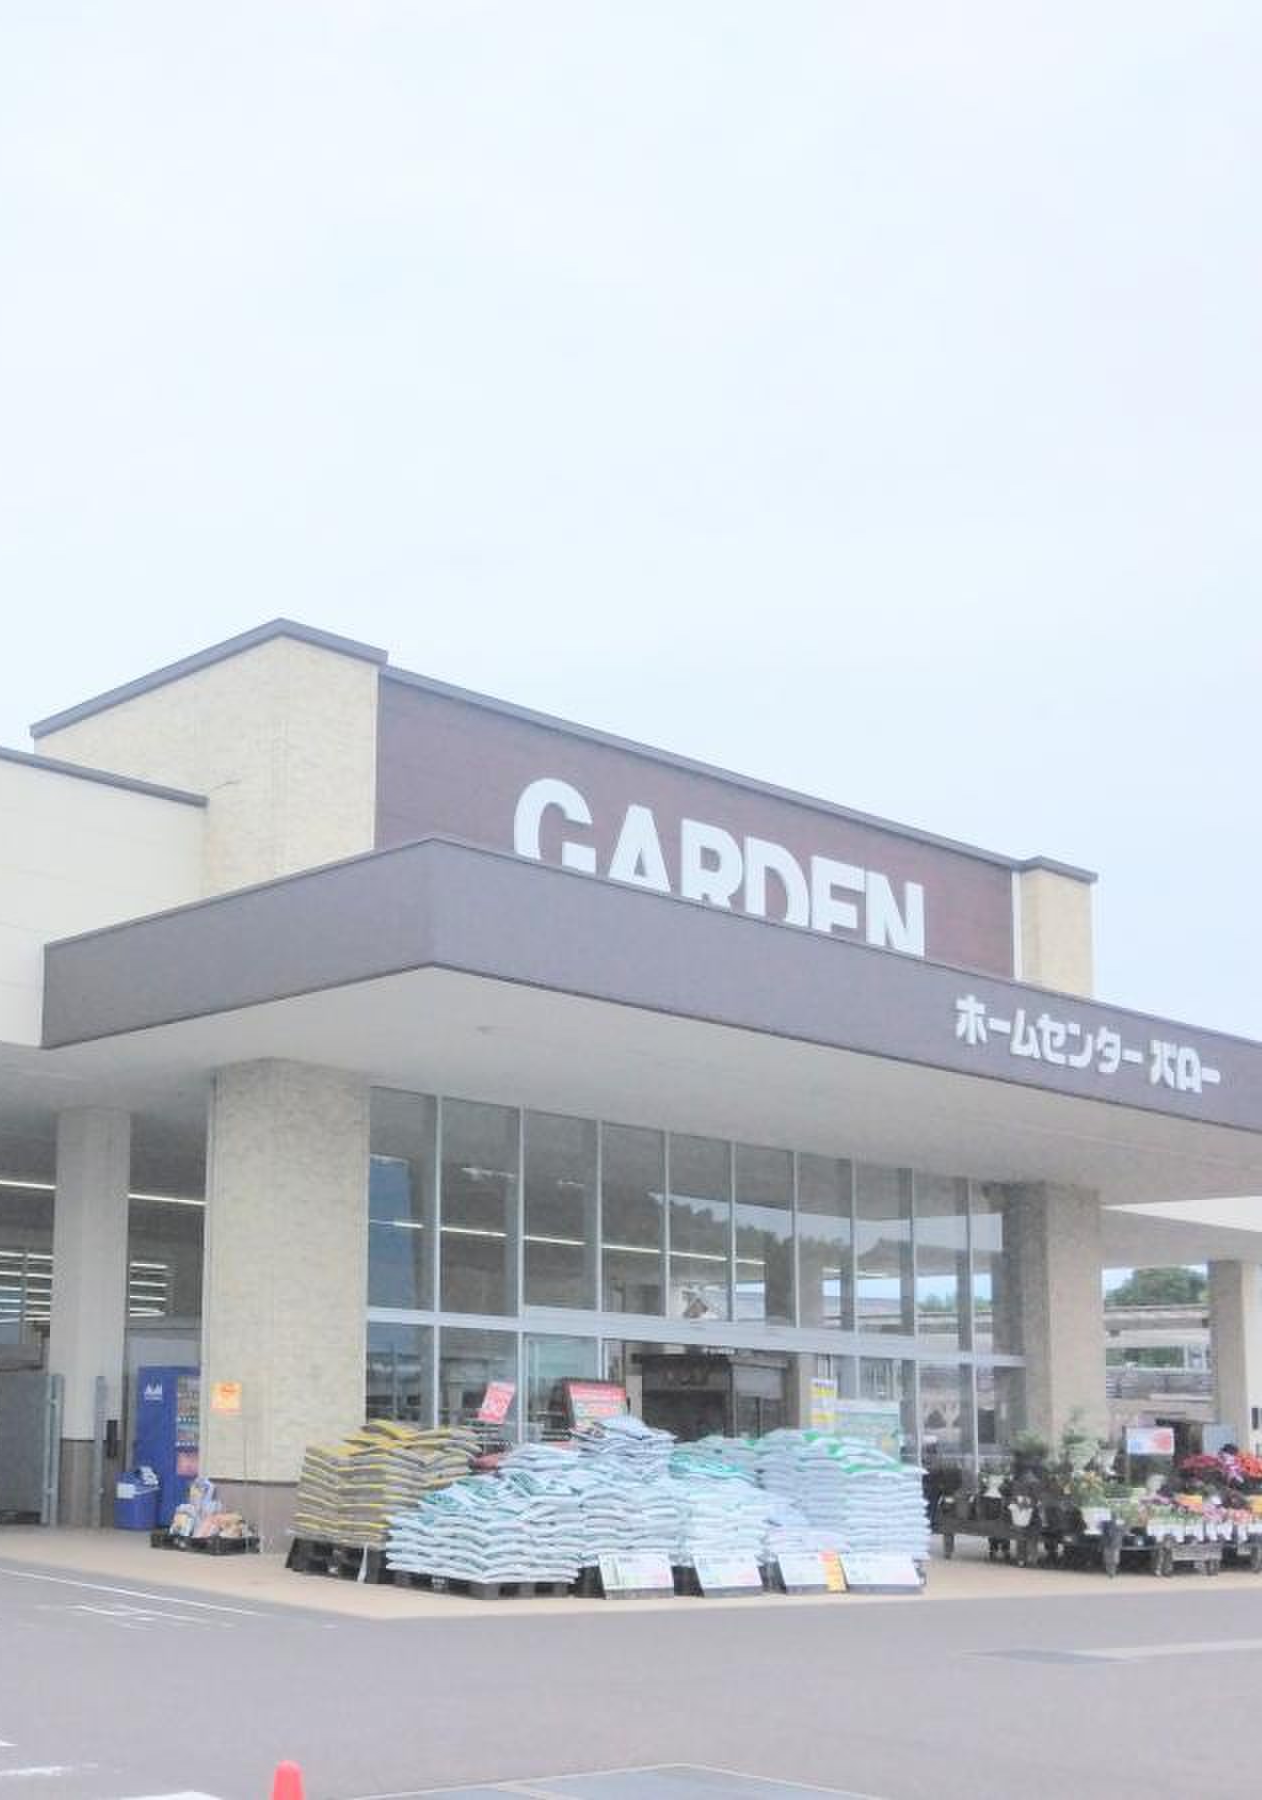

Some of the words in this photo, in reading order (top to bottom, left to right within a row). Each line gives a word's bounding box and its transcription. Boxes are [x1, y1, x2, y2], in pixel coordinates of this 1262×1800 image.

[514, 778, 925, 957] GARDEN
[955, 994, 1143, 1073] ホームセンター
[1150, 1039, 1220, 1093] バロー
